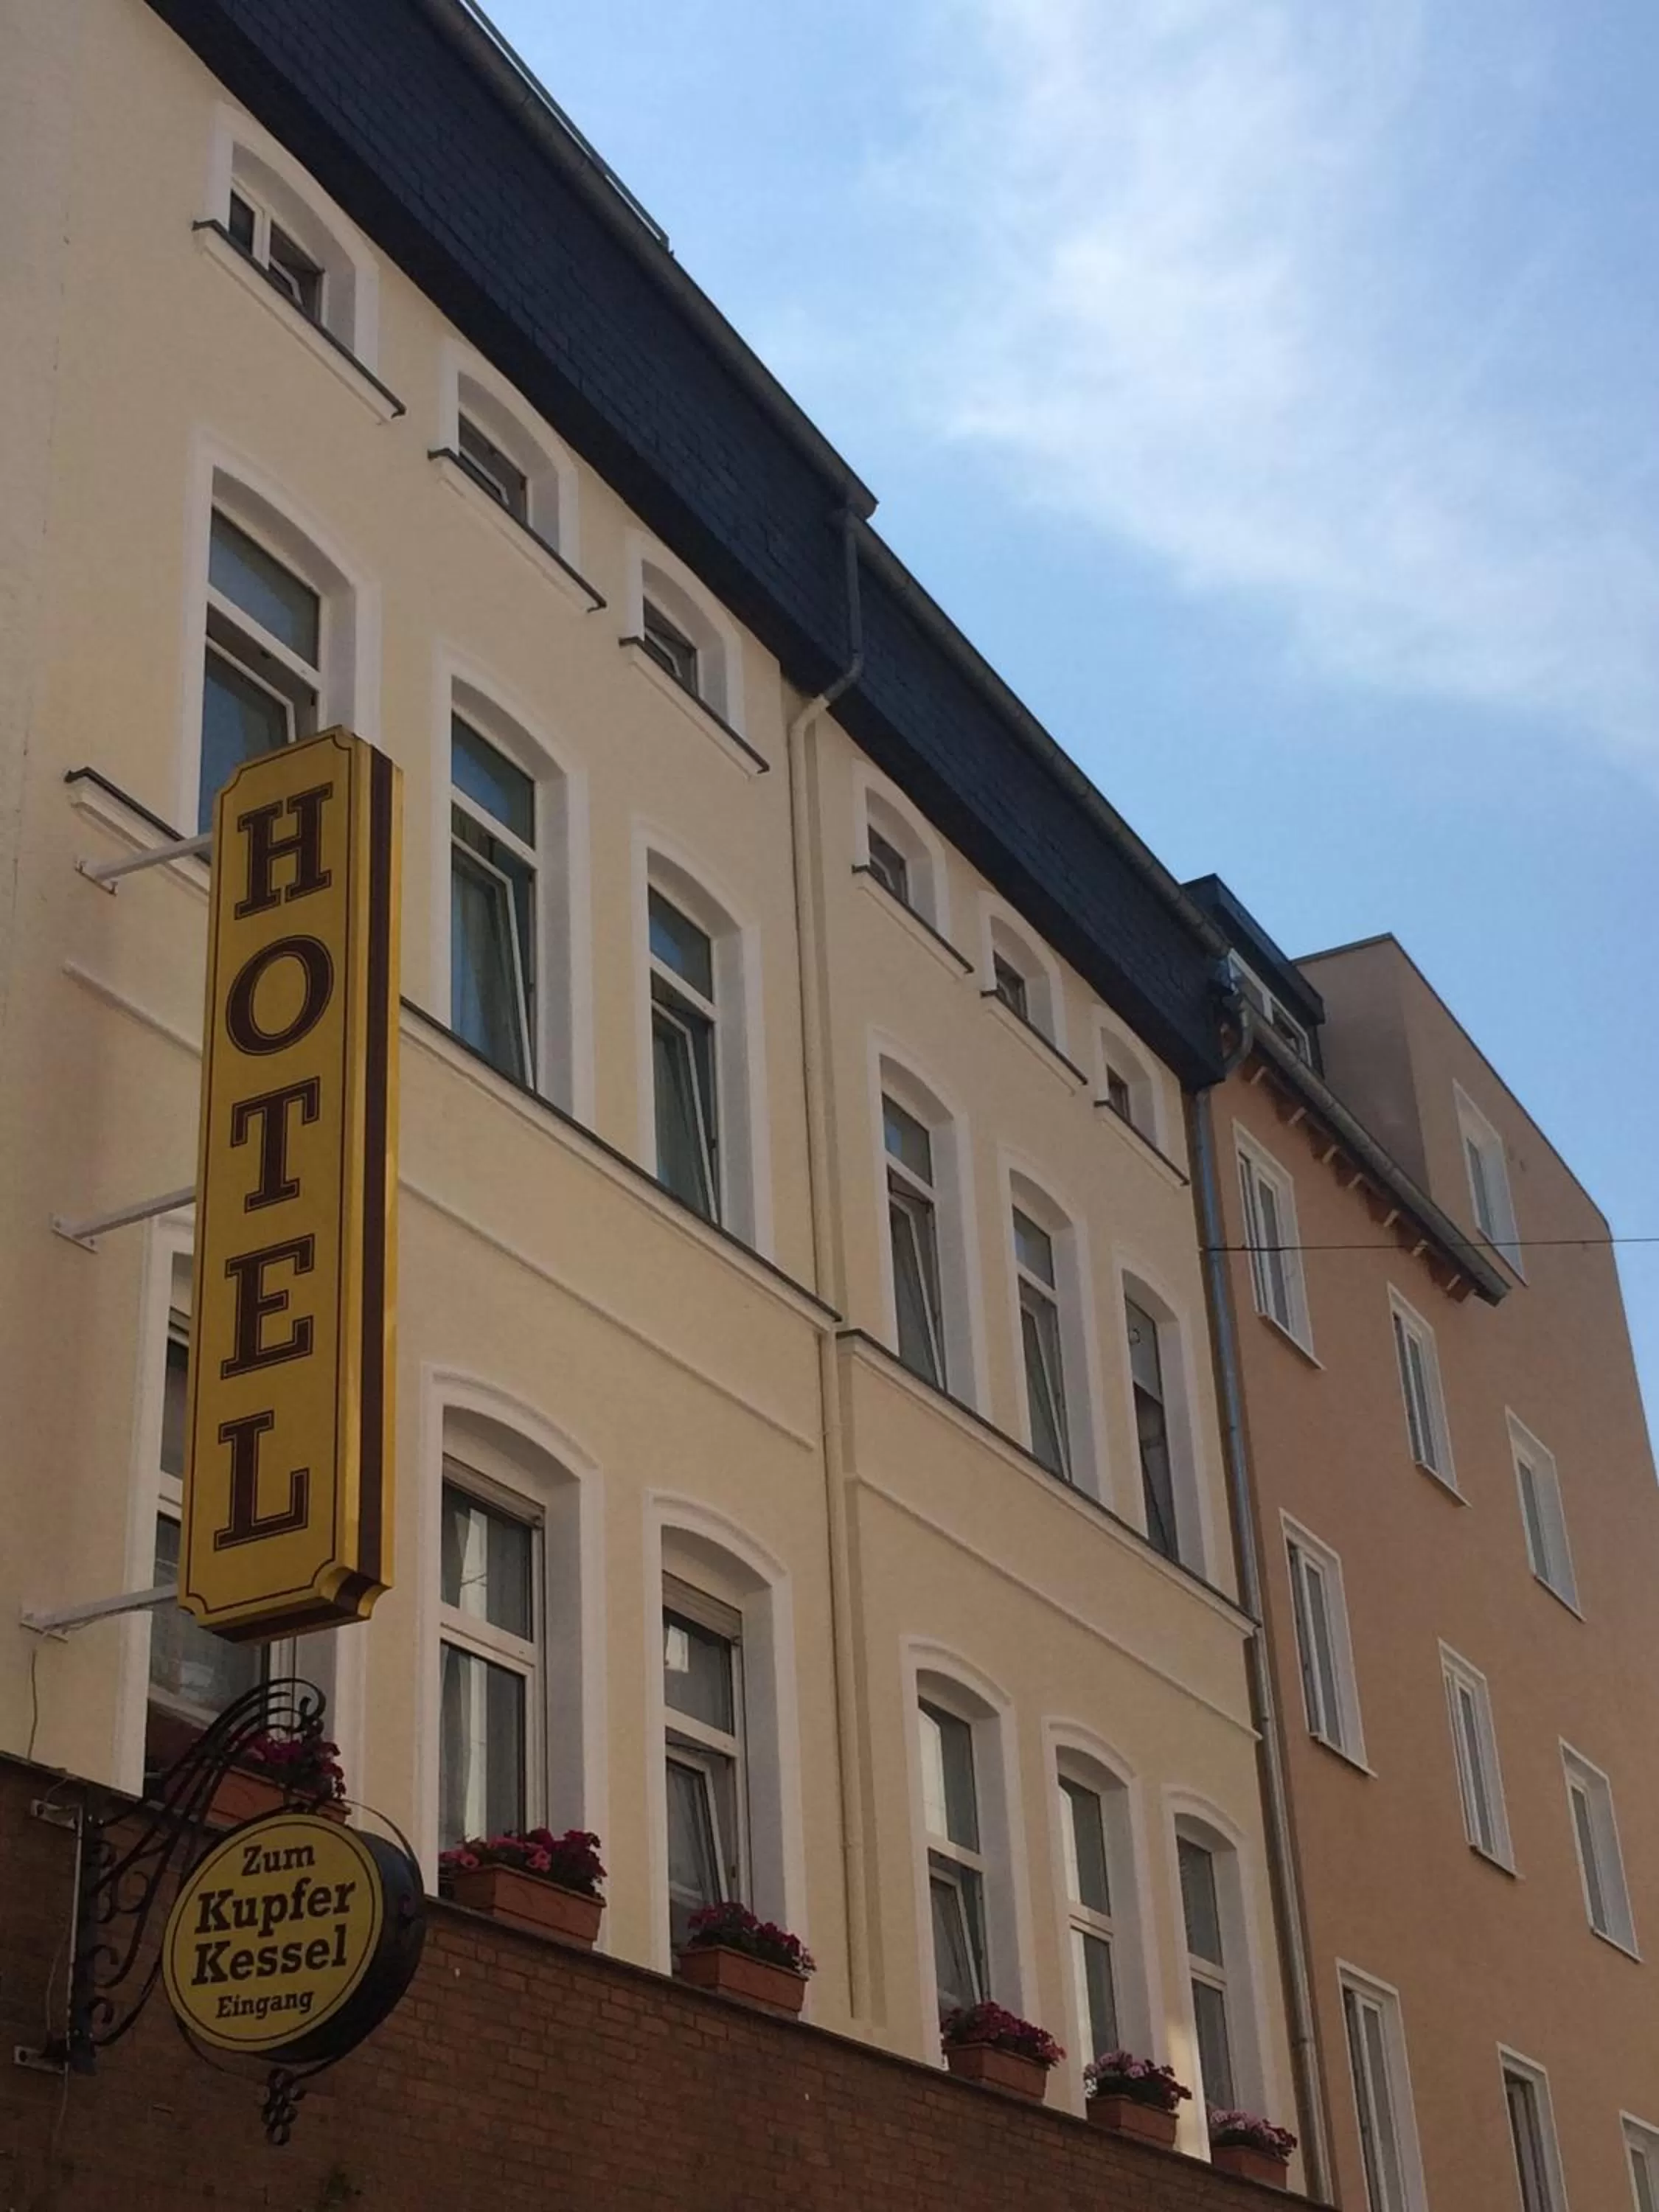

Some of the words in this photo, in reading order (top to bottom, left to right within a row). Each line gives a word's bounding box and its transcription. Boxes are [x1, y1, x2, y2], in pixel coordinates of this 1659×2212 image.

[214, 782, 335, 1551] HOTEL
[241, 1844, 315, 1877] Zum
[194, 1877, 356, 1938] Kupfer
[190, 1924, 347, 1986] Kessel
[215, 1991, 314, 2020] Eingang
